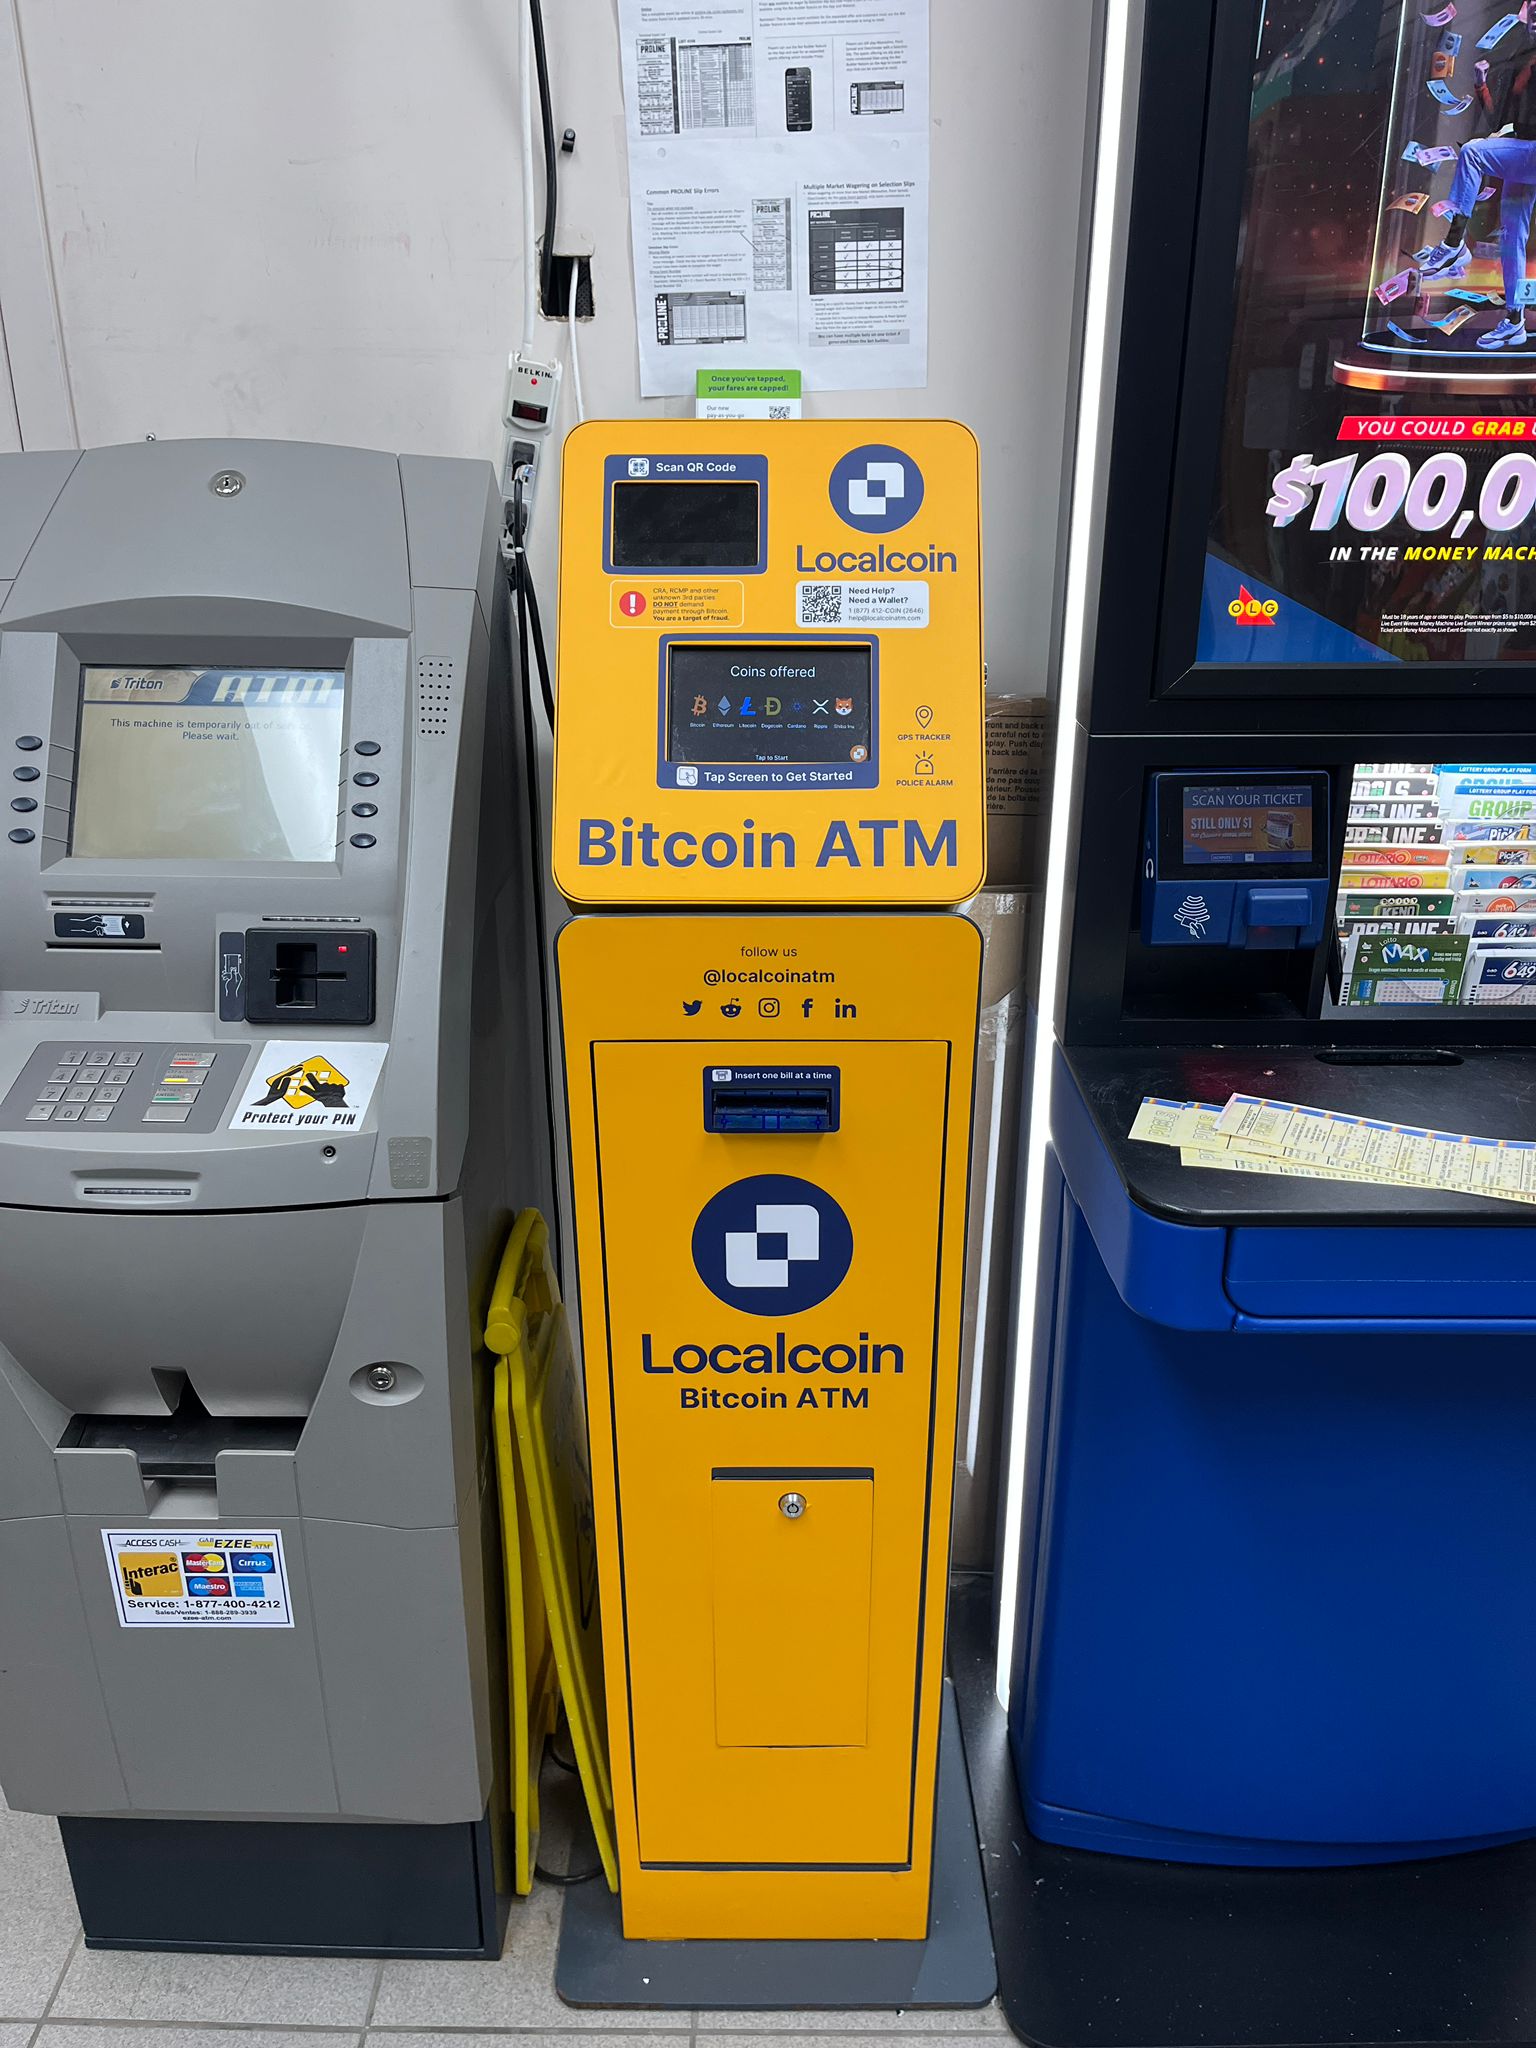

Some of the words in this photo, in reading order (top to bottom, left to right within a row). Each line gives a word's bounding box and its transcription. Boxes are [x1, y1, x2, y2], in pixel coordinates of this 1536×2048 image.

[803, 183, 825, 191] Multiple
[846, 182, 870, 190] Wagering
[518, 367, 551, 378] BELKIN
[731, 375, 756, 383] you've
[757, 375, 786, 383] tapped,
[759, 385, 789, 393] capped!
[1357, 421, 1396, 436] YOU
[1401, 421, 1465, 436] COULD
[1472, 421, 1525, 436] GRAB
[656, 462, 685, 473] Scan
[687, 462, 704, 474] QR
[706, 462, 737, 473] Code
[1265, 452, 1536, 539] $100,0
[796, 544, 957, 573] Localcoin
[1329, 547, 1352, 561] IN
[1359, 546, 1399, 561] THE
[1403, 546, 1478, 561] MONEY
[849, 587, 870, 595] Need
[871, 587, 895, 596] Help?
[878, 596, 908, 604] Wallet?
[681, 608, 705, 616] through
[853, 607, 870, 615] (877)
[903, 607, 924, 615] (2646)
[1230, 601, 1277, 615] OLG
[683, 615, 702, 623] target
[849, 614, 921, 622] help@localcoinatm.com
[730, 665, 766, 678] Coins
[769, 665, 817, 679] offered
[123, 676, 164, 691] Triton
[212, 676, 337, 704] ATM
[111, 719, 130, 728] This
[133, 719, 173, 729] machine
[176, 720, 184, 728] is
[187, 720, 242, 731] temporarily
[244, 721, 260, 729] out
[182, 731, 213, 741] Please
[216, 731, 240, 741] wait.
[990, 730, 1016, 739] careful
[1017, 731, 1030, 739] not
[1032, 731, 1040, 739] to
[991, 748, 1010, 757] back
[704, 771, 725, 784] Tap
[728, 772, 769, 782] Screen
[771, 772, 784, 782] to
[785, 772, 807, 782] Get
[809, 771, 853, 781] Started
[896, 779, 924, 787] POLICE
[925, 779, 953, 787] ALARM
[1192, 795, 1224, 806] SCAN
[1227, 794, 1260, 805] YOUR
[1263, 793, 1303, 805] TICKET
[1468, 799, 1533, 818] GROUP
[1191, 817, 1217, 830] STILL
[1218, 816, 1242, 830] ONLY
[1243, 816, 1252, 829] $1
[578, 816, 796, 869] Bitcoin
[815, 819, 958, 868] ATM
[1382, 906, 1416, 916] KENO
[1380, 937, 1398, 947] Lotto
[741, 945, 779, 957] follow
[782, 948, 798, 957] us
[1381, 943, 1429, 964] MAX
[703, 968, 835, 986] @localcoinatm
[32, 999, 80, 1015] Triton
[735, 1071, 761, 1080] Insert
[780, 1071, 794, 1080] bill
[795, 1072, 804, 1080] at
[812, 1071, 832, 1080] time
[242, 1111, 294, 1124] Protect
[296, 1114, 328, 1126] your
[332, 1113, 356, 1125] PIN
[641, 1332, 904, 1374] Localcoin
[680, 1386, 787, 1409] Bitcoin
[795, 1387, 869, 1409] ATM
[126, 1539, 157, 1547] ACCESS
[159, 1539, 182, 1547] CASH
[214, 1539, 253, 1549] EZEE
[186, 1559, 224, 1567] MasterCard
[238, 1559, 267, 1567] Cirrus
[123, 1562, 179, 1581] Interac
[128, 1600, 179, 1608] Service:
[184, 1600, 281, 1608] 1-877-400-4212
